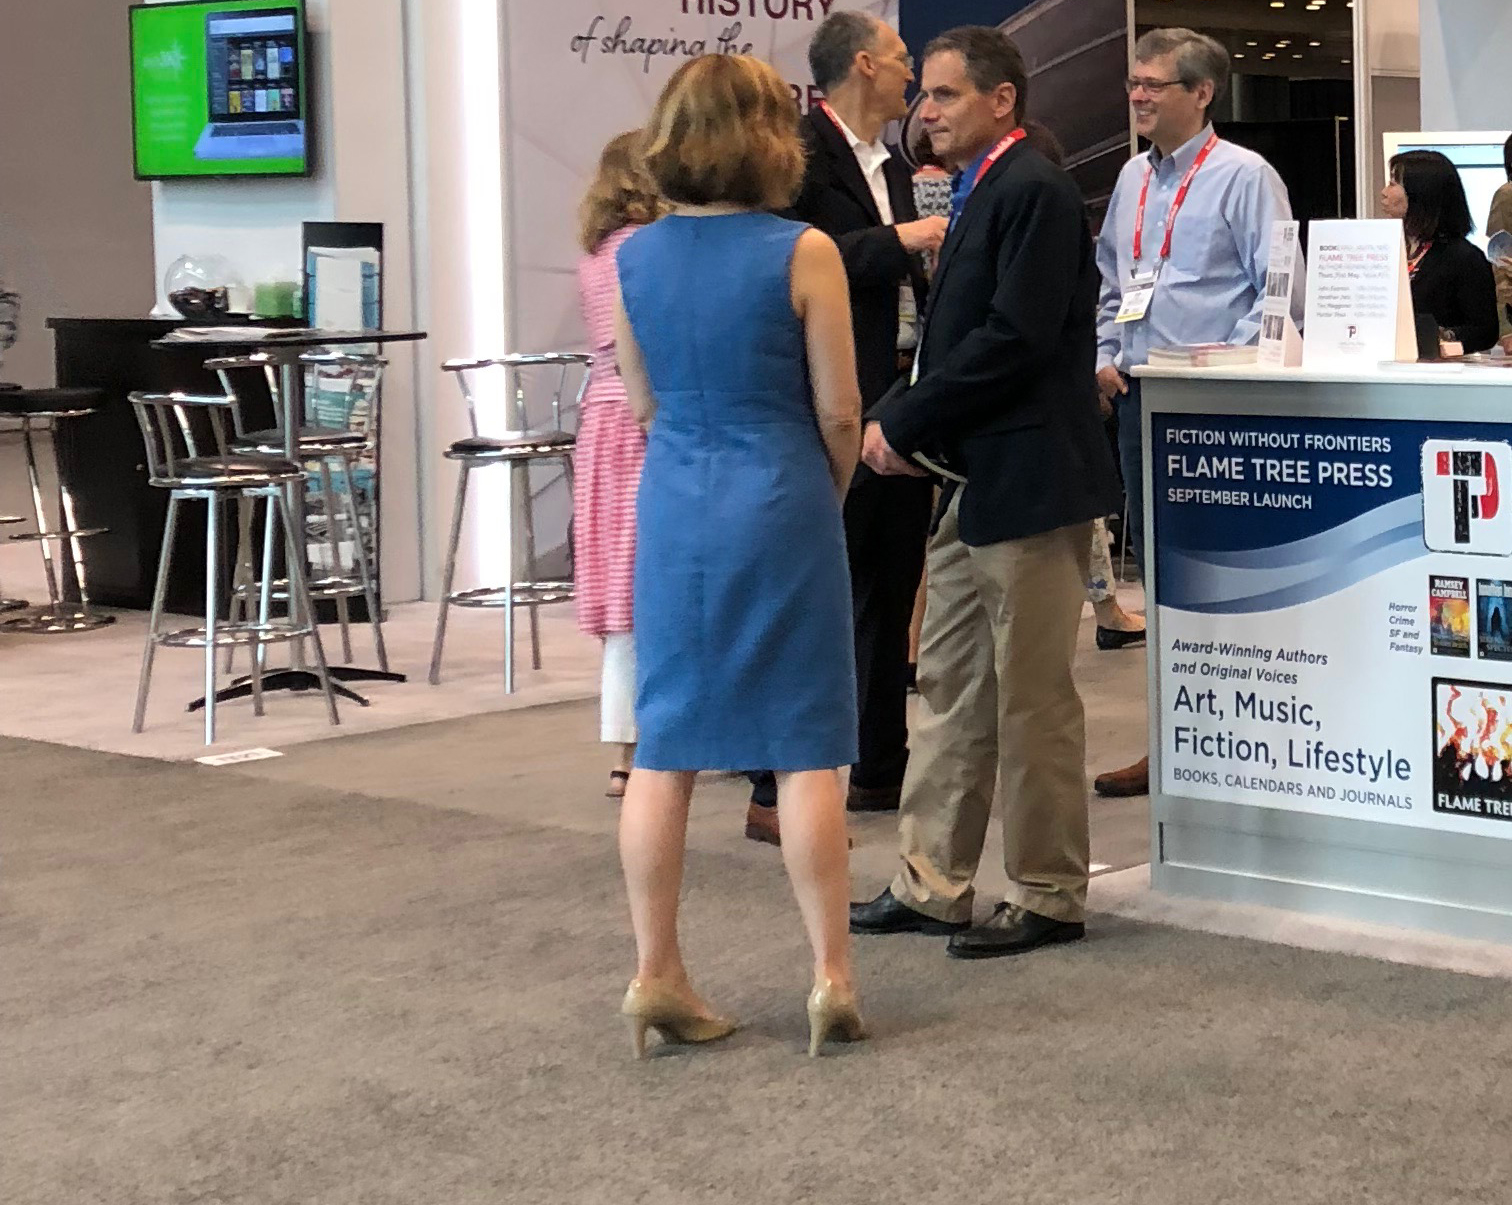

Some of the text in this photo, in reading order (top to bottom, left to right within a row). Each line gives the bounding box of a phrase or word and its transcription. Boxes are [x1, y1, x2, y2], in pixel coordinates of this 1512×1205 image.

[570, 15, 604, 64] of
[716, 21, 754, 57] the
[1165, 428, 1392, 454] FICTION WITHOUT FRONTIERS
[1167, 455, 1393, 489] FLAME TREE PRESS
[1167, 488, 1313, 511] SEPTEMBER LAUNCH
[1435, 579, 1463, 590] RAMSEY
[1388, 602, 1418, 613] Horror
[1388, 615, 1416, 626] Crime
[1389, 628, 1420, 640] SF and
[1171, 638, 1328, 666] Award-Winning Authors
[1389, 642, 1424, 656] Fantasy
[1171, 661, 1298, 685] and Original Voices
[1173, 684, 1322, 732] Art, Music,
[1174, 726, 1412, 783] Fiction, Lifestyle
[1173, 767, 1413, 810] BOOKS, CALENDARS AND JOURNALS
[1437, 794, 1482, 813] FLAME
